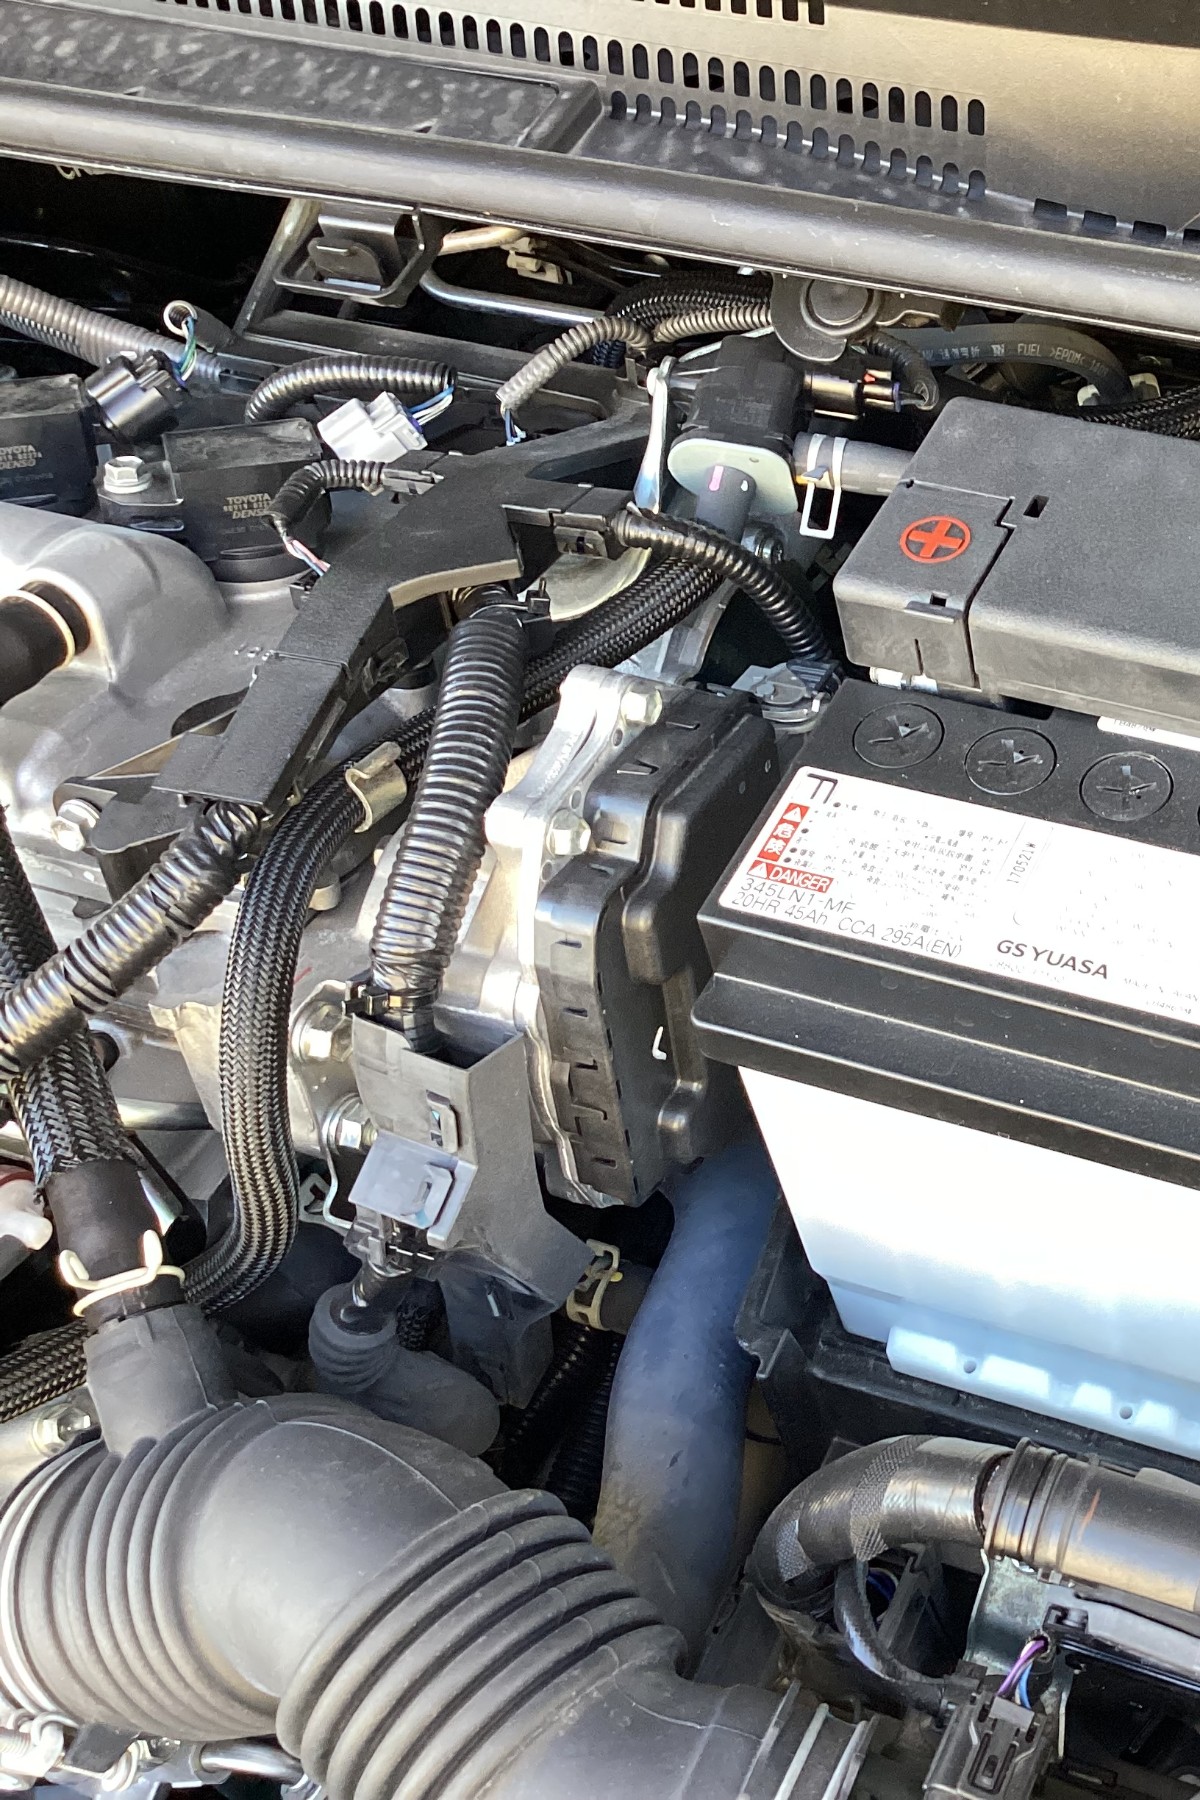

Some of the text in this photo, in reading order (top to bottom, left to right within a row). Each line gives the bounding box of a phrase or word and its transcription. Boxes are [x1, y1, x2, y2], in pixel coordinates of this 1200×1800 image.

[1017, 343, 1042, 357] FUEL
[0, 445, 36, 456] OYOTA
[226, 493, 271, 505] TOYOTA
[232, 508, 266, 519] DENS
[768, 866, 830, 892] DANGER
[741, 878, 856, 914] 345LN1-MF
[732, 892, 962, 958] 20HR 45Ah CCA 295A(EN)
[997, 940, 1027, 958] GS
[1032, 945, 1109, 979] YUASA
